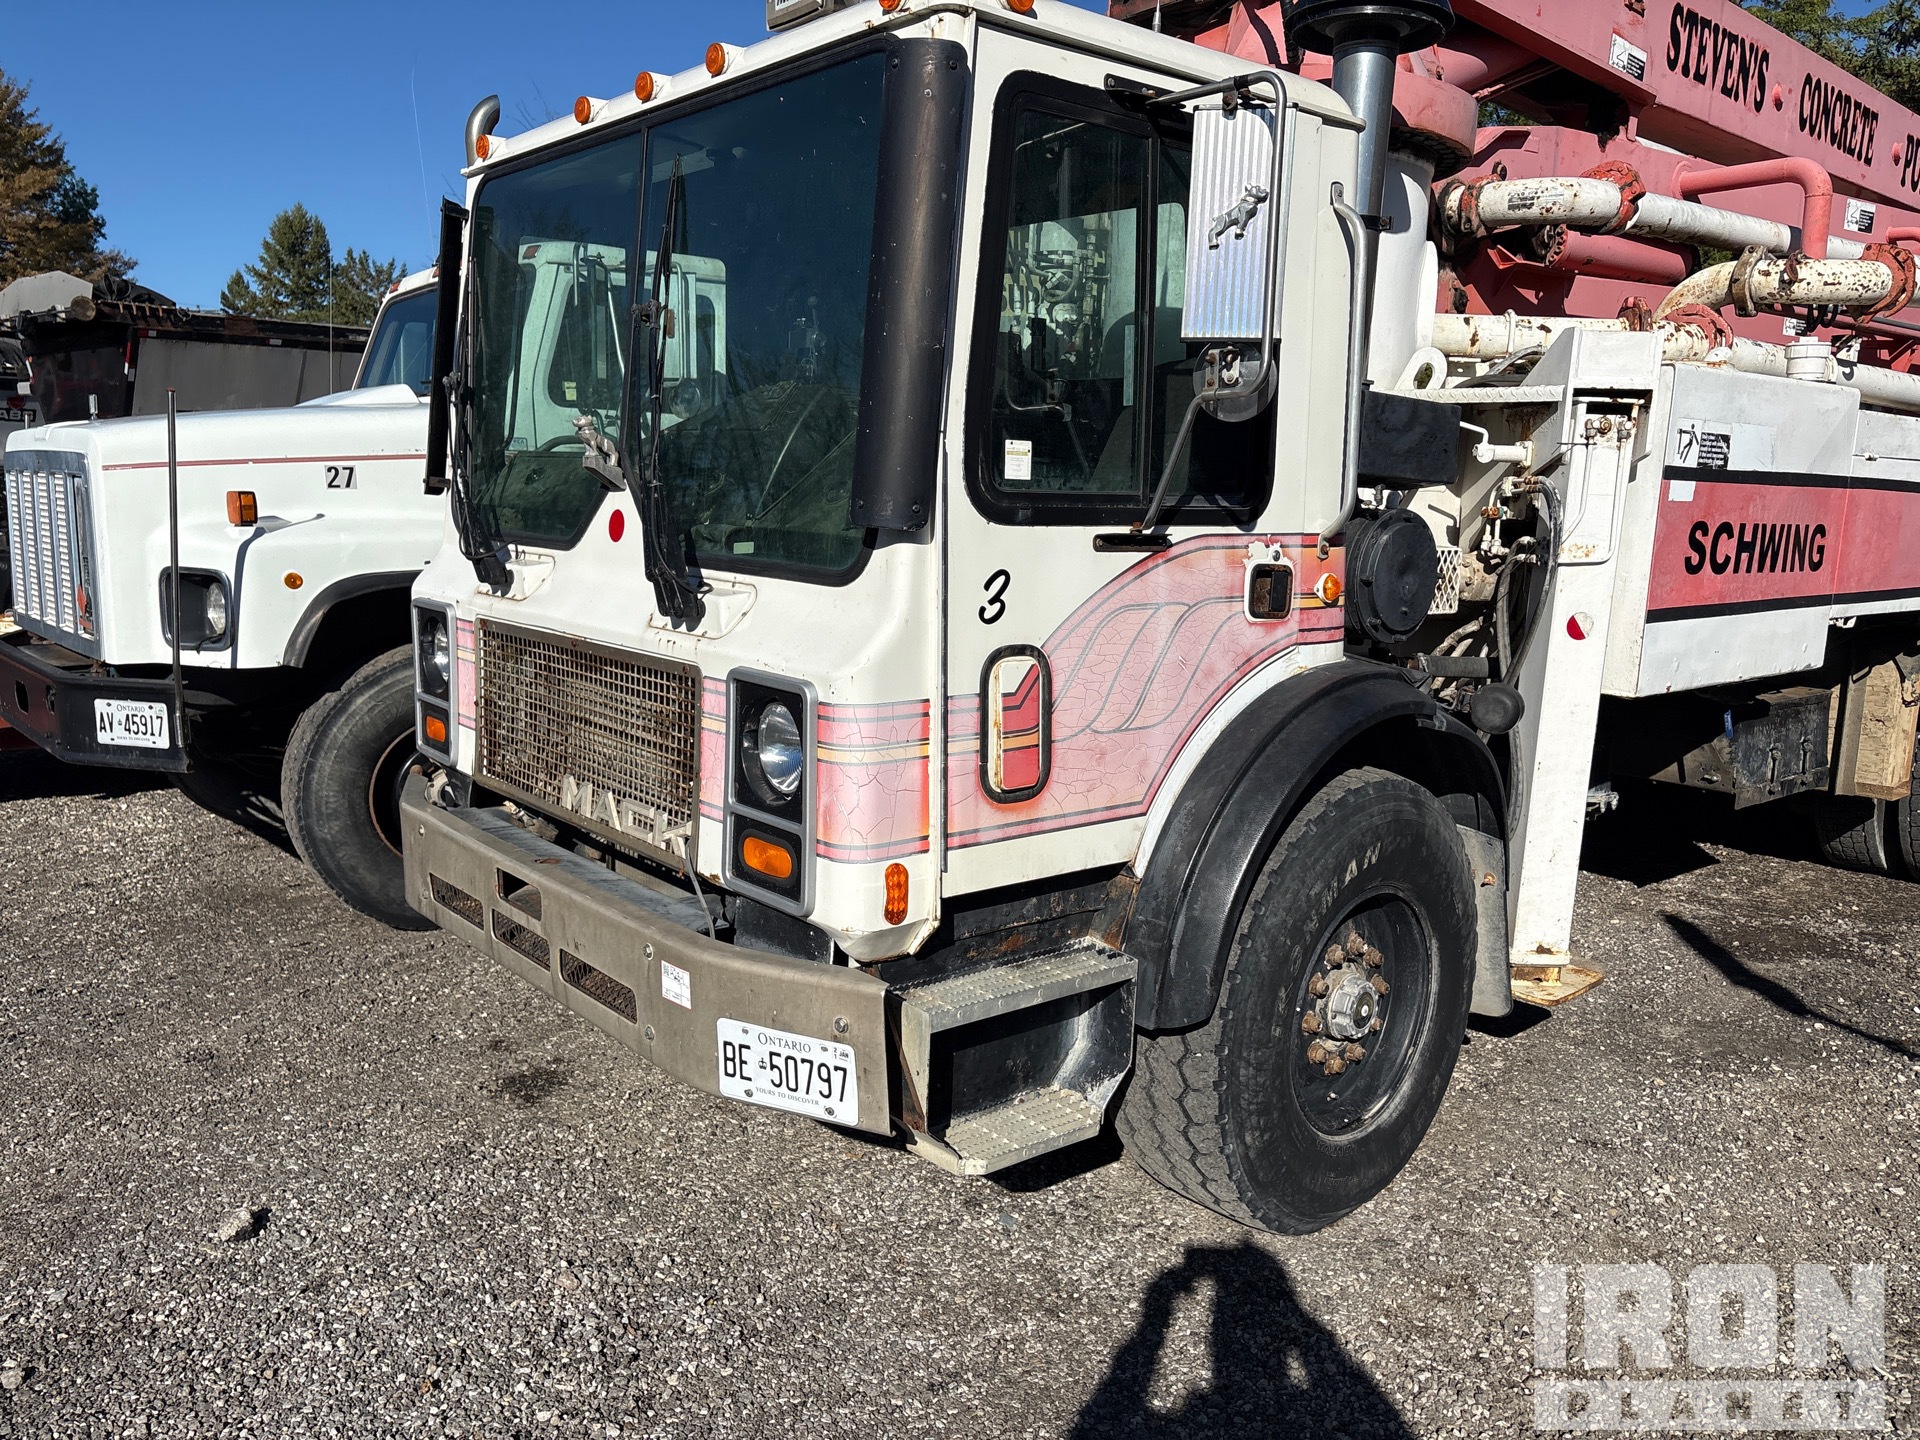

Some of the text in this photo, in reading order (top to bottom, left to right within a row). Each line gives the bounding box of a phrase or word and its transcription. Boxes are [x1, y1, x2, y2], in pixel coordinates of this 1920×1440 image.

[1667, 2, 1769, 113] STEVEN'S
[1799, 72, 1879, 167] CONCRETE
[327, 466, 354, 488] 27
[1684, 520, 1826, 575] SCHWING
[978, 568, 1011, 625] 3
[116, 704, 145, 713] ONTARIO
[99, 712, 163, 737] AV 45917
[757, 1032, 811, 1053] ONTARIO
[723, 1040, 847, 1102] BE 50797
[755, 1086, 820, 1106] YOURS TO DISCOVER
